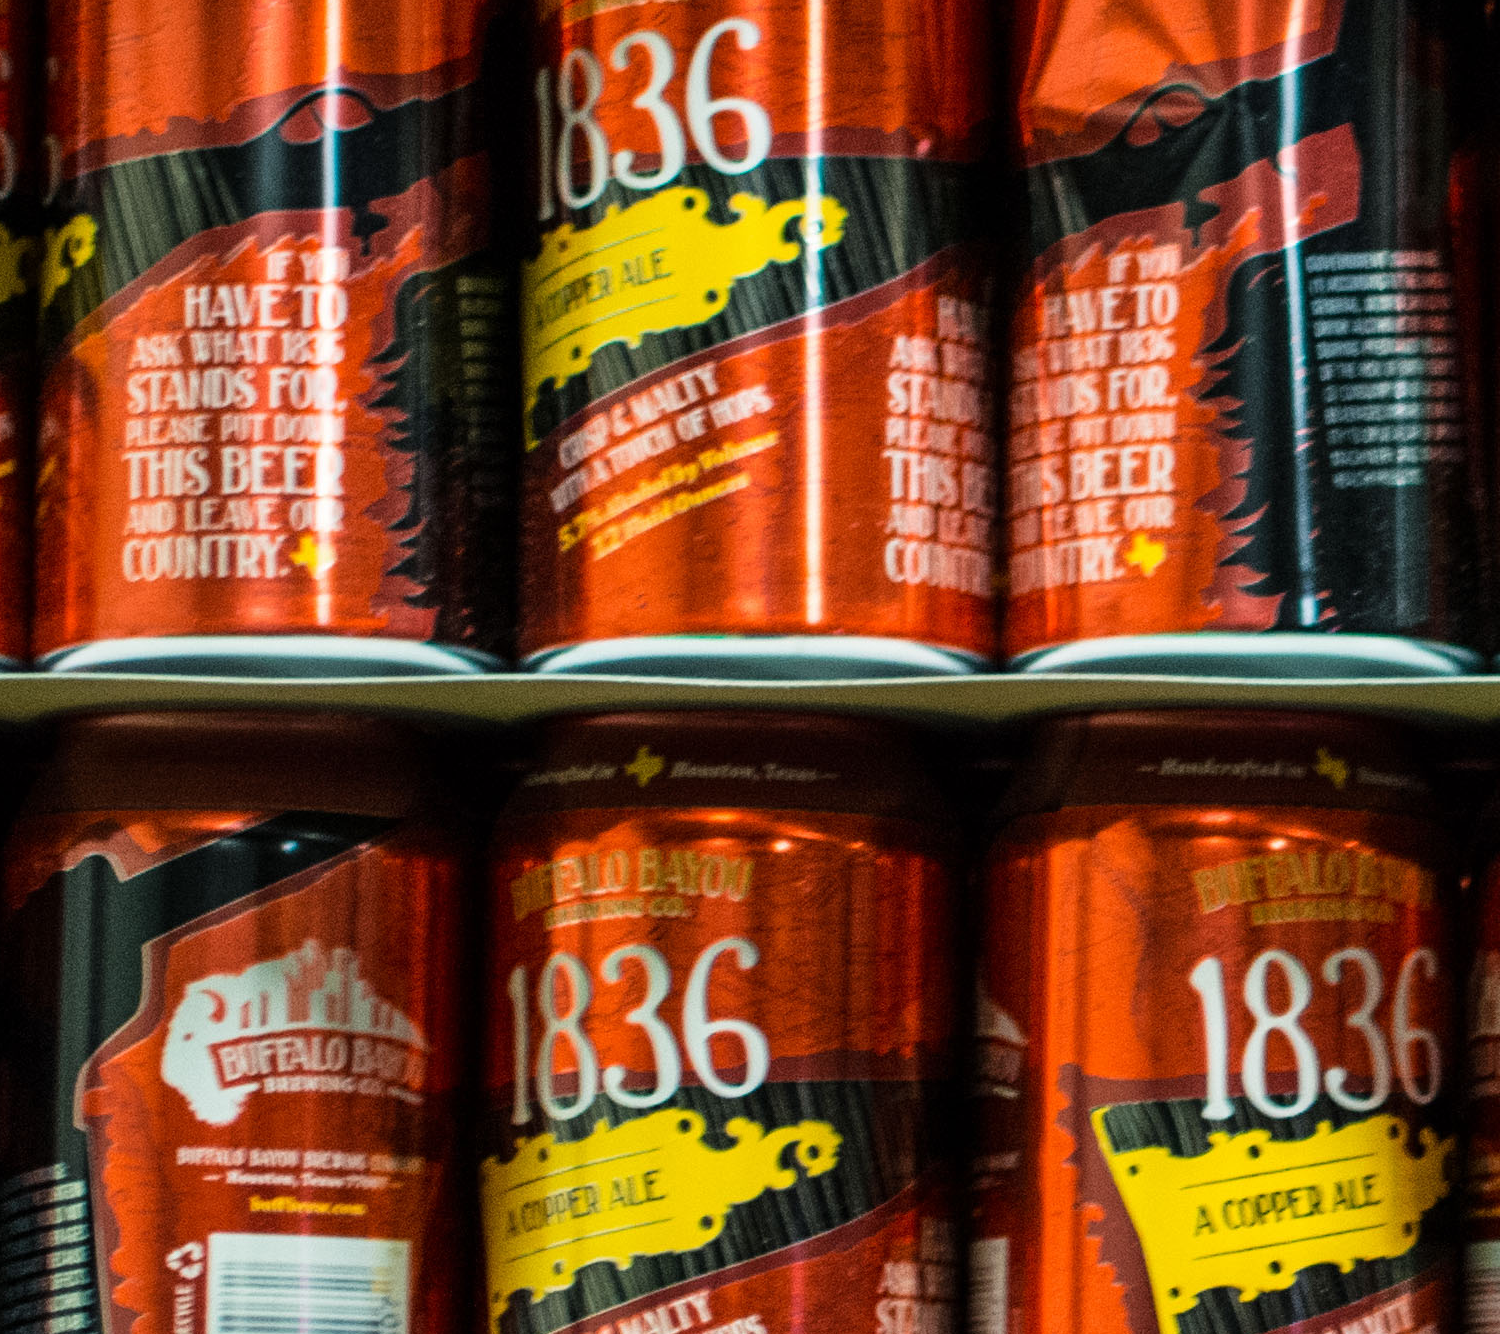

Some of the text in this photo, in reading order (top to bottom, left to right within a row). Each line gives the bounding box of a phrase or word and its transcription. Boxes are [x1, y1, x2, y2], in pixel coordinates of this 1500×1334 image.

[535, 17, 771, 221] 1836
[616, 249, 672, 288] ALE
[184, 284, 347, 329] HAVE TO
[128, 372, 257, 413] STANDS
[124, 450, 344, 497] THIS BEER
[1070, 446, 1173, 495] BEER
[508, 938, 769, 1124] 1836
[1190, 949, 1439, 1119] 1836
[218, 1034, 346, 1079] BUFFALO
[521, 1169, 665, 1235] COPPER ALE
[1222, 1188, 1323, 1229] COPPER
[1333, 1176, 1383, 1211] ALE
